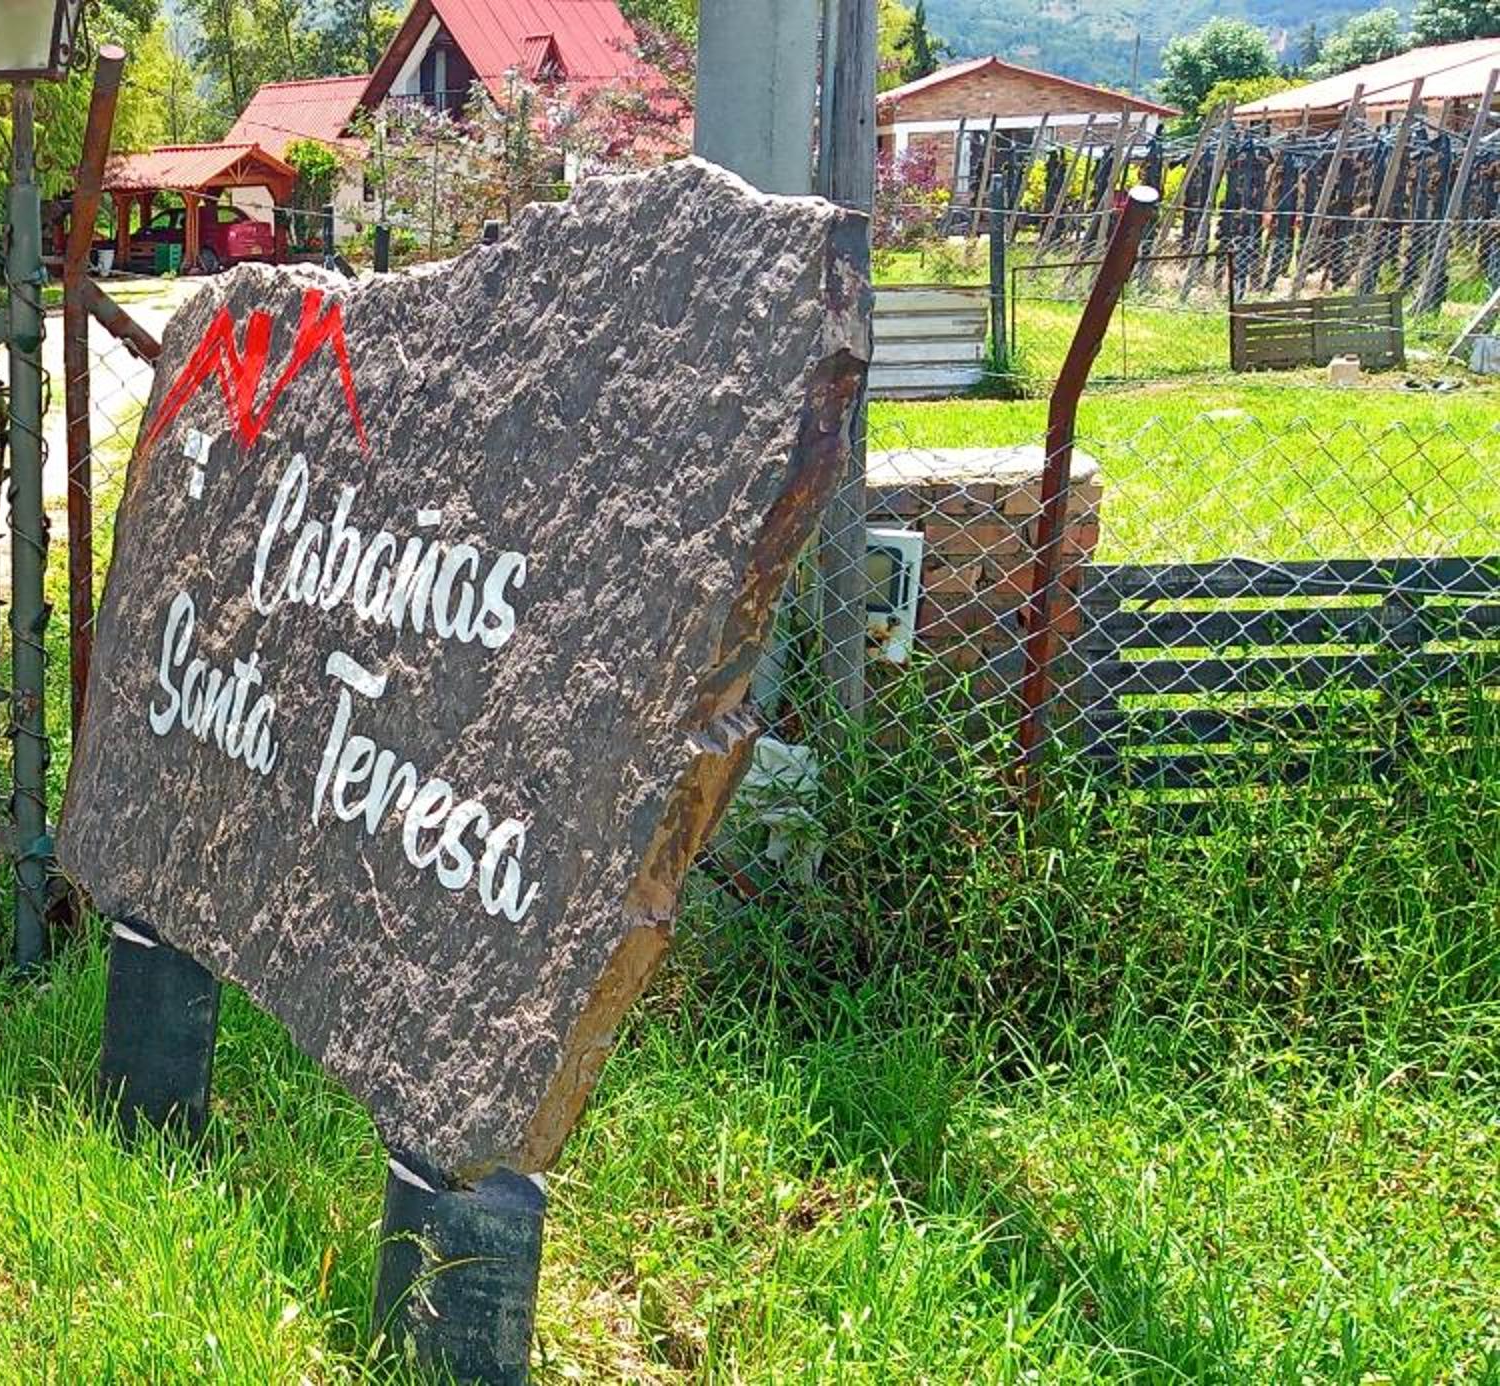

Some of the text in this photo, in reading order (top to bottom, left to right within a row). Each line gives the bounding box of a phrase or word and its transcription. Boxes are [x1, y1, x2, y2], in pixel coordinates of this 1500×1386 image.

[252, 453, 527, 649] Cabañas
[149, 593, 540, 922] Santa Teresa
